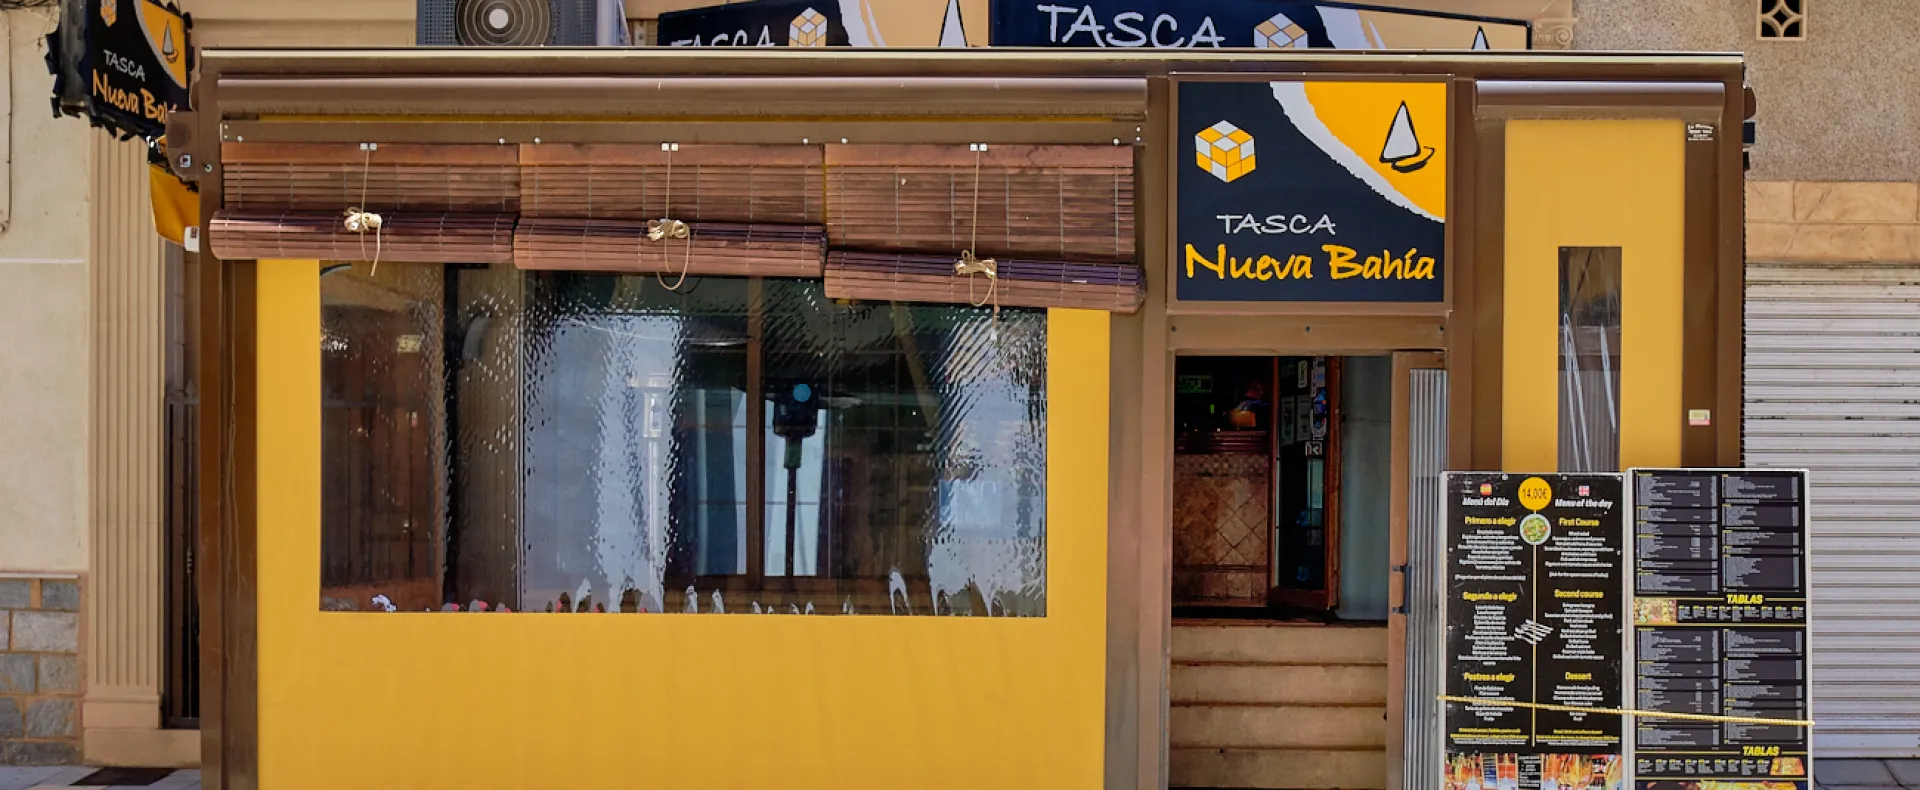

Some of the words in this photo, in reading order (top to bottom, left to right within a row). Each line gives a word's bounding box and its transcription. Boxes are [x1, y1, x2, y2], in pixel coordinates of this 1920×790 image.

[1037, 4, 1226, 48] TASCA
[103, 49, 145, 82] TASCA
[92, 68, 140, 114] Nueva
[1216, 213, 1336, 236] TASCA
[1185, 243, 1314, 281] Nueva
[1322, 243, 1436, 281] Bahía
[1559, 517, 1575, 527] First
[1575, 517, 1600, 527] Course
[1554, 588, 1580, 599] Second
[1726, 594, 1764, 605] TABLAS
[1742, 745, 1780, 757] TABLAS
